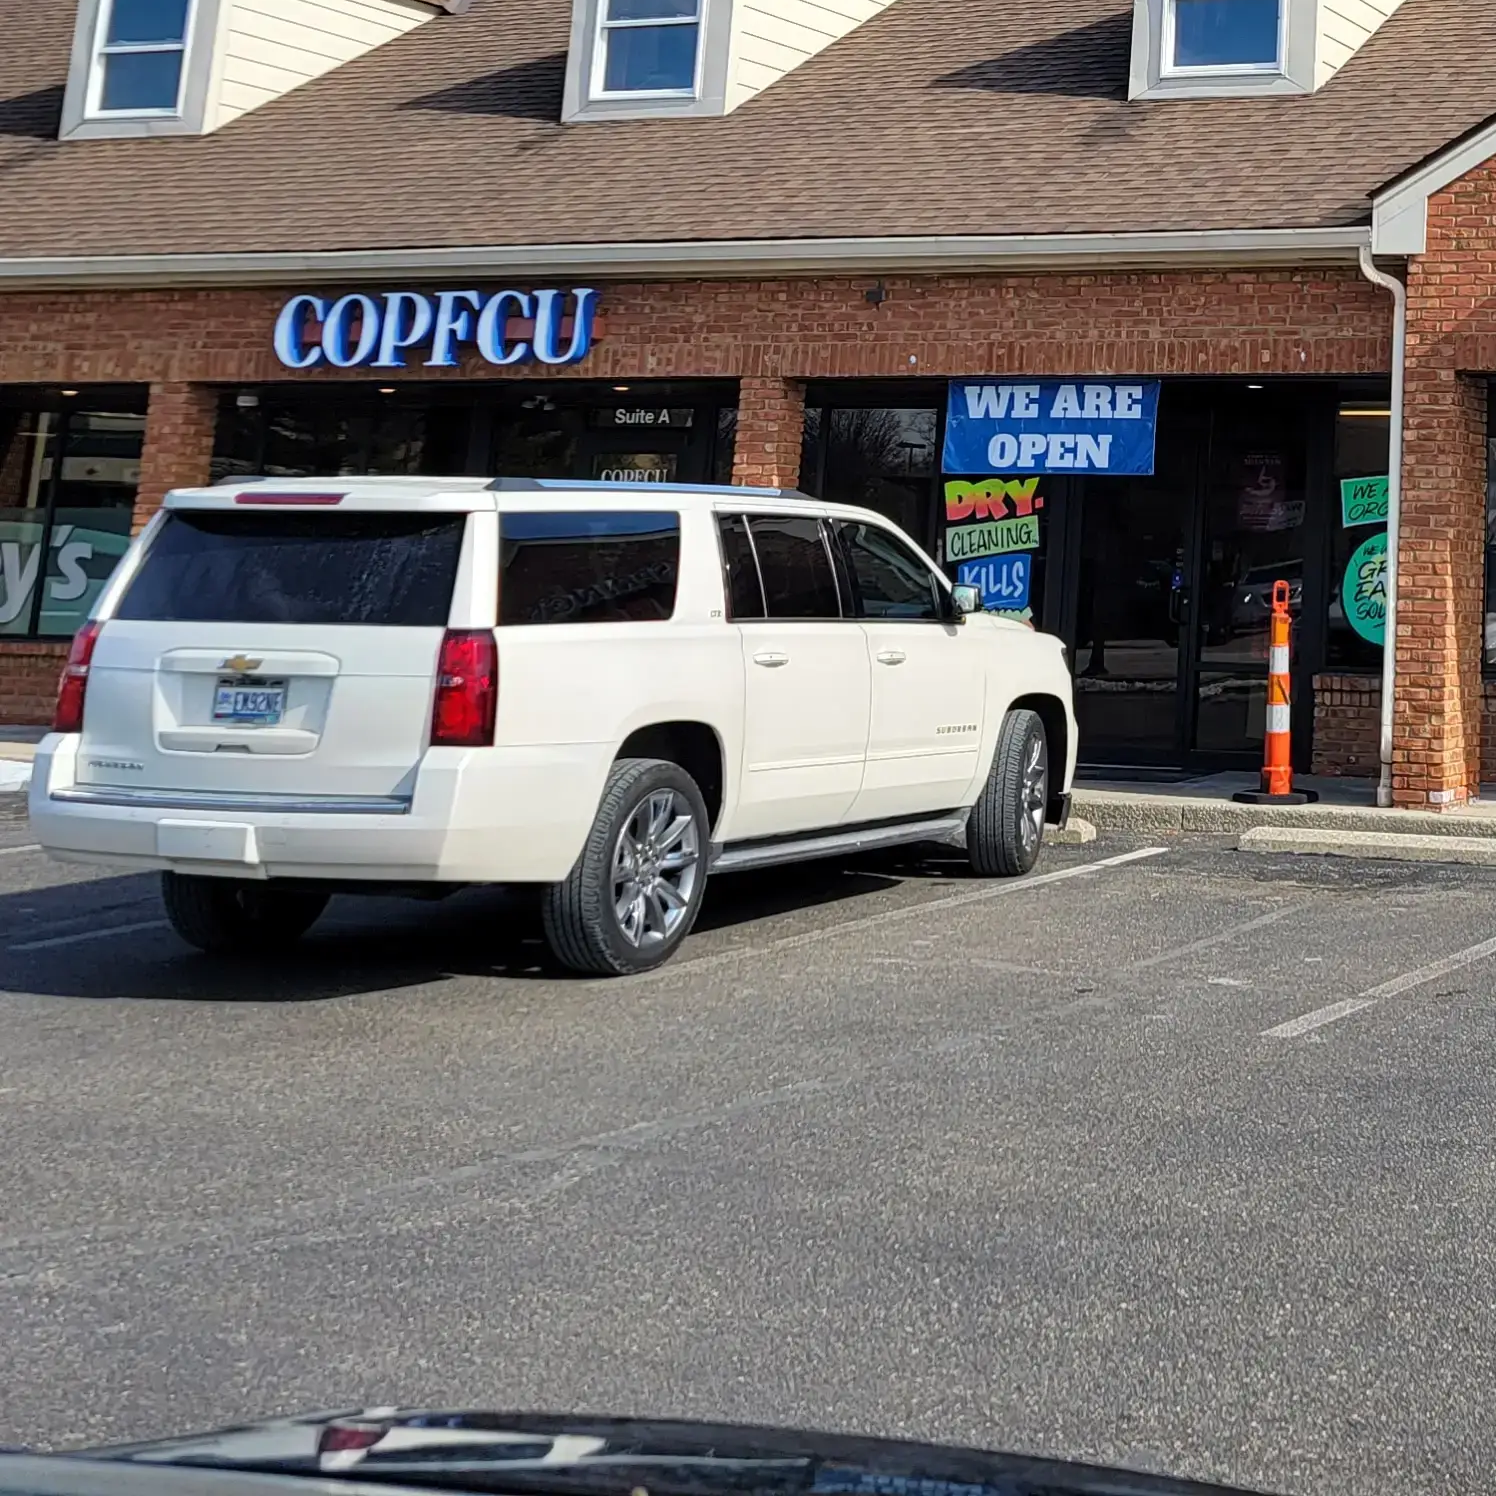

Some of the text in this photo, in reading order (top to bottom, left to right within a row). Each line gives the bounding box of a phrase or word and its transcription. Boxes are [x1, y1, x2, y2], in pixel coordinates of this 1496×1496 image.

[273, 287, 598, 369] COPFCU
[964, 384, 1143, 419] WE ARE
[614, 408, 670, 424] Suite A
[987, 433, 1113, 469] OPEN
[1352, 483, 1379, 500] WE
[1348, 501, 1388, 521] ORG
[963, 561, 1025, 600] KILLS
[1357, 560, 1388, 581] GR
[1354, 581, 1387, 603] EA
[936, 724, 977, 735] SUBURBAN
